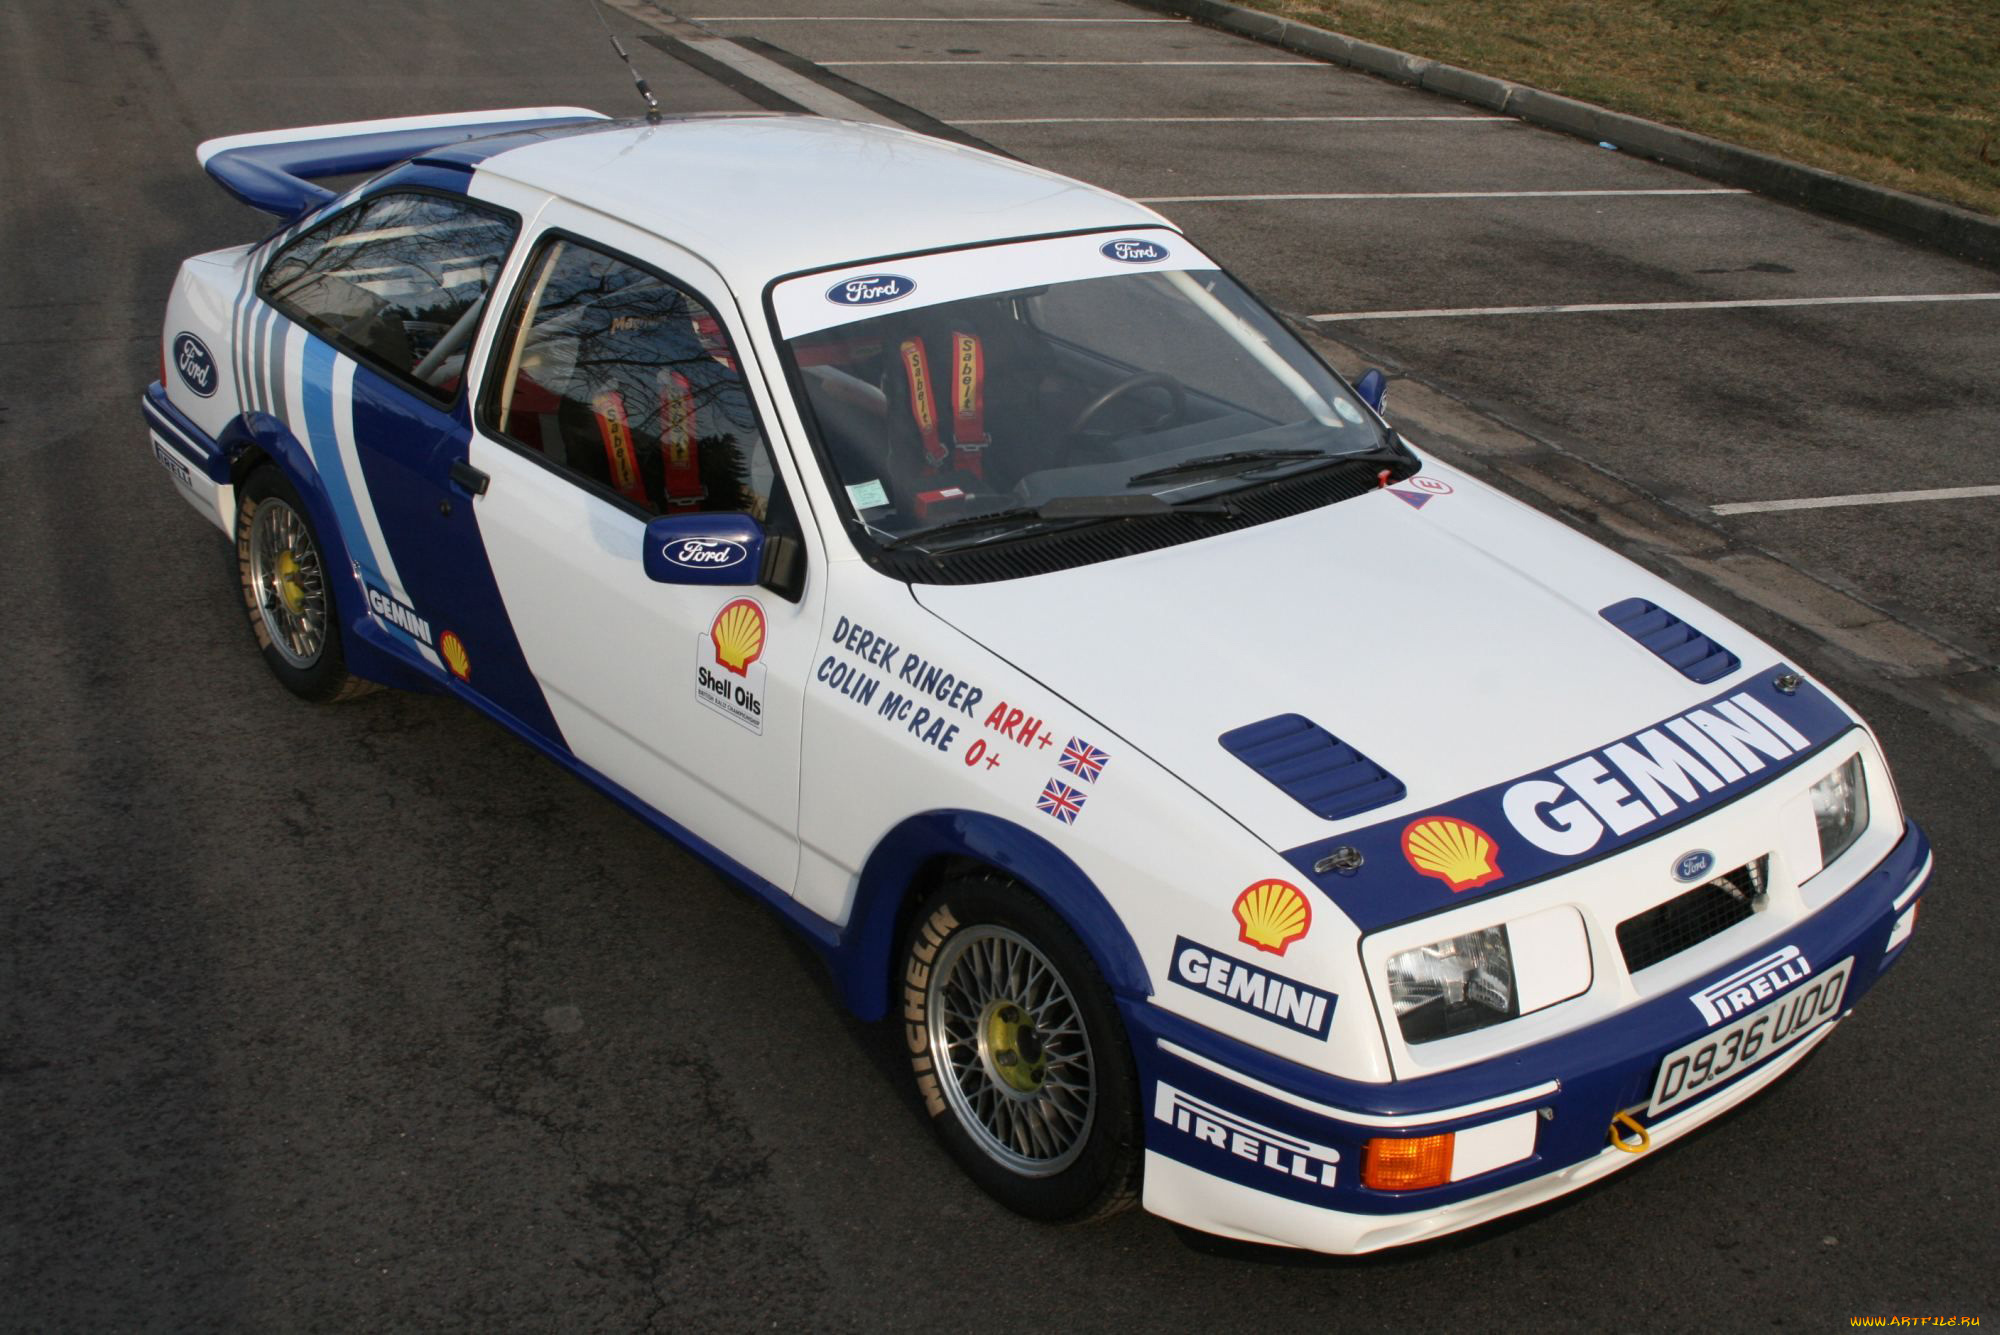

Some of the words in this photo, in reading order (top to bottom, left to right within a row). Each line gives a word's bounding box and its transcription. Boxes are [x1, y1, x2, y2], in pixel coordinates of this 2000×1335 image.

[1115, 242, 1157, 260] Ford
[846, 278, 899, 303] Ford
[180, 339, 211, 388] Ford
[912, 354, 928, 423] Sabelt
[962, 339, 973, 409] Sabelt
[155, 440, 193, 488] PIRELLI
[607, 409, 629, 482] Sabelt
[678, 541, 731, 562] Ford
[369, 589, 433, 645] GEMINI
[698, 666, 731, 700] Shell
[734, 686, 761, 716] Oils
[817, 656, 880, 706] COLIN
[832, 615, 900, 674] DEREK
[899, 653, 983, 718] RINGER
[1502, 691, 1812, 856] GEMINI
[1683, 855, 1707, 876] Ford
[904, 903, 961, 1118] MICHELIN
[1178, 948, 1328, 1032] GEMINI
[1689, 945, 1811, 1027] PIRELLI
[1658, 1015, 1768, 1105] D936
[1154, 1079, 1341, 1188] PIRELLI
